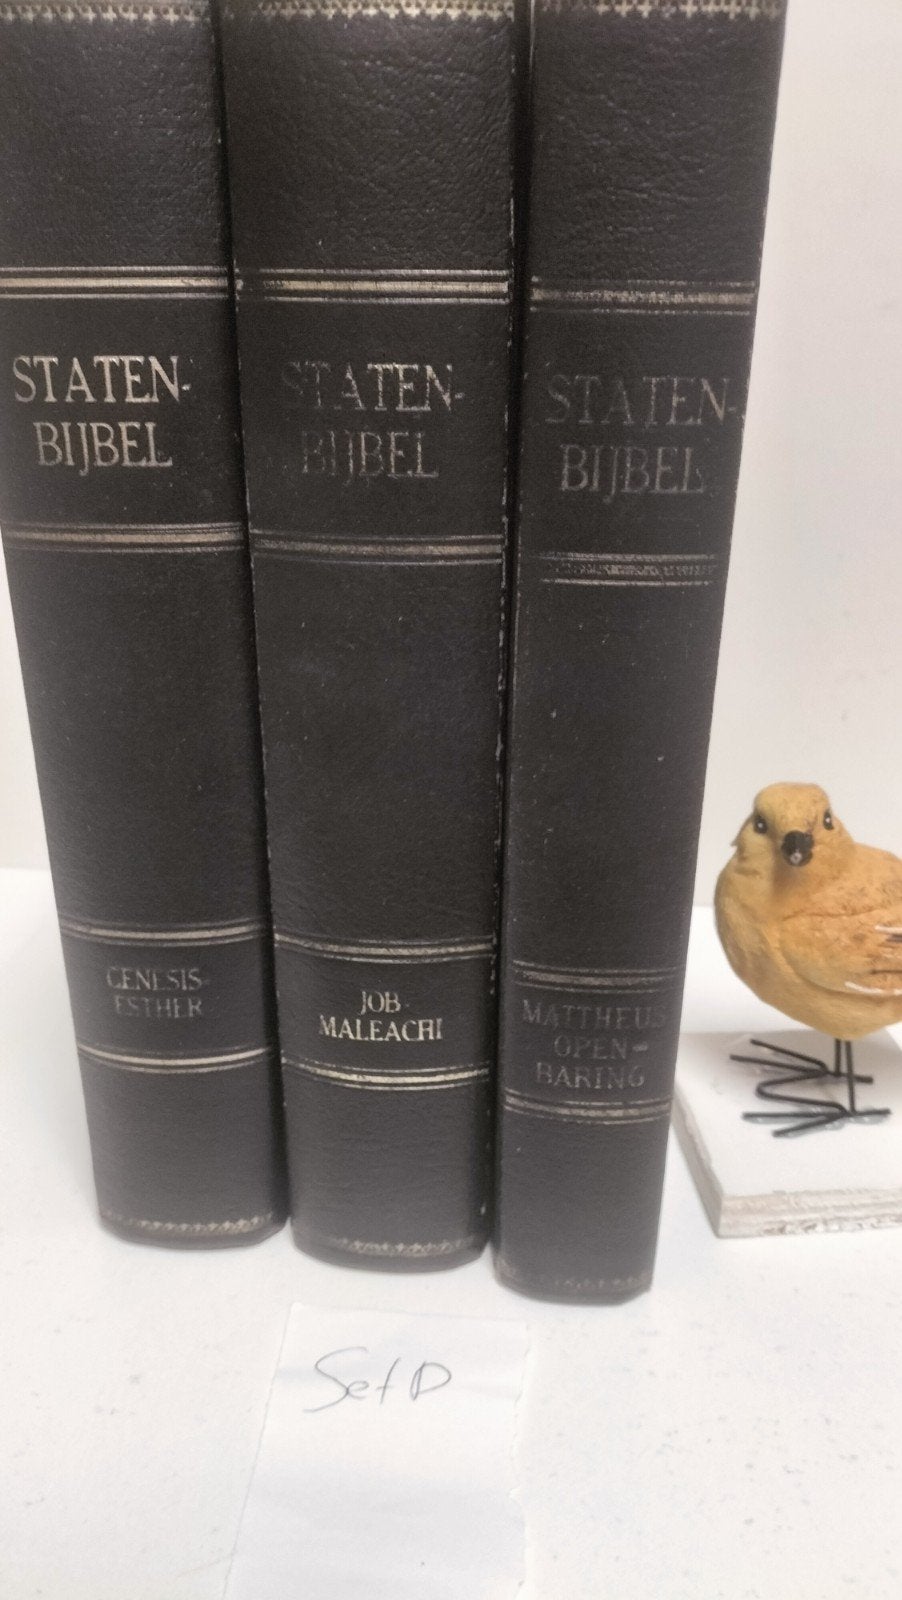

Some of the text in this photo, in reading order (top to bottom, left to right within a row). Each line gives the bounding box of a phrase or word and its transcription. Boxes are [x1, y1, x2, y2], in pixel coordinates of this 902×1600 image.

[13, 355, 191, 403] STATEN-
[545, 374, 737, 426] STATEN-
[33, 421, 173, 476] BIJBEL
[302, 429, 440, 486] BIJBEL
[560, 443, 704, 503] BIJBEL
[319, 1014, 443, 1042] MALEACHI
[536, 1062, 646, 1090] BARING
[302, 1346, 452, 1413] Set D
